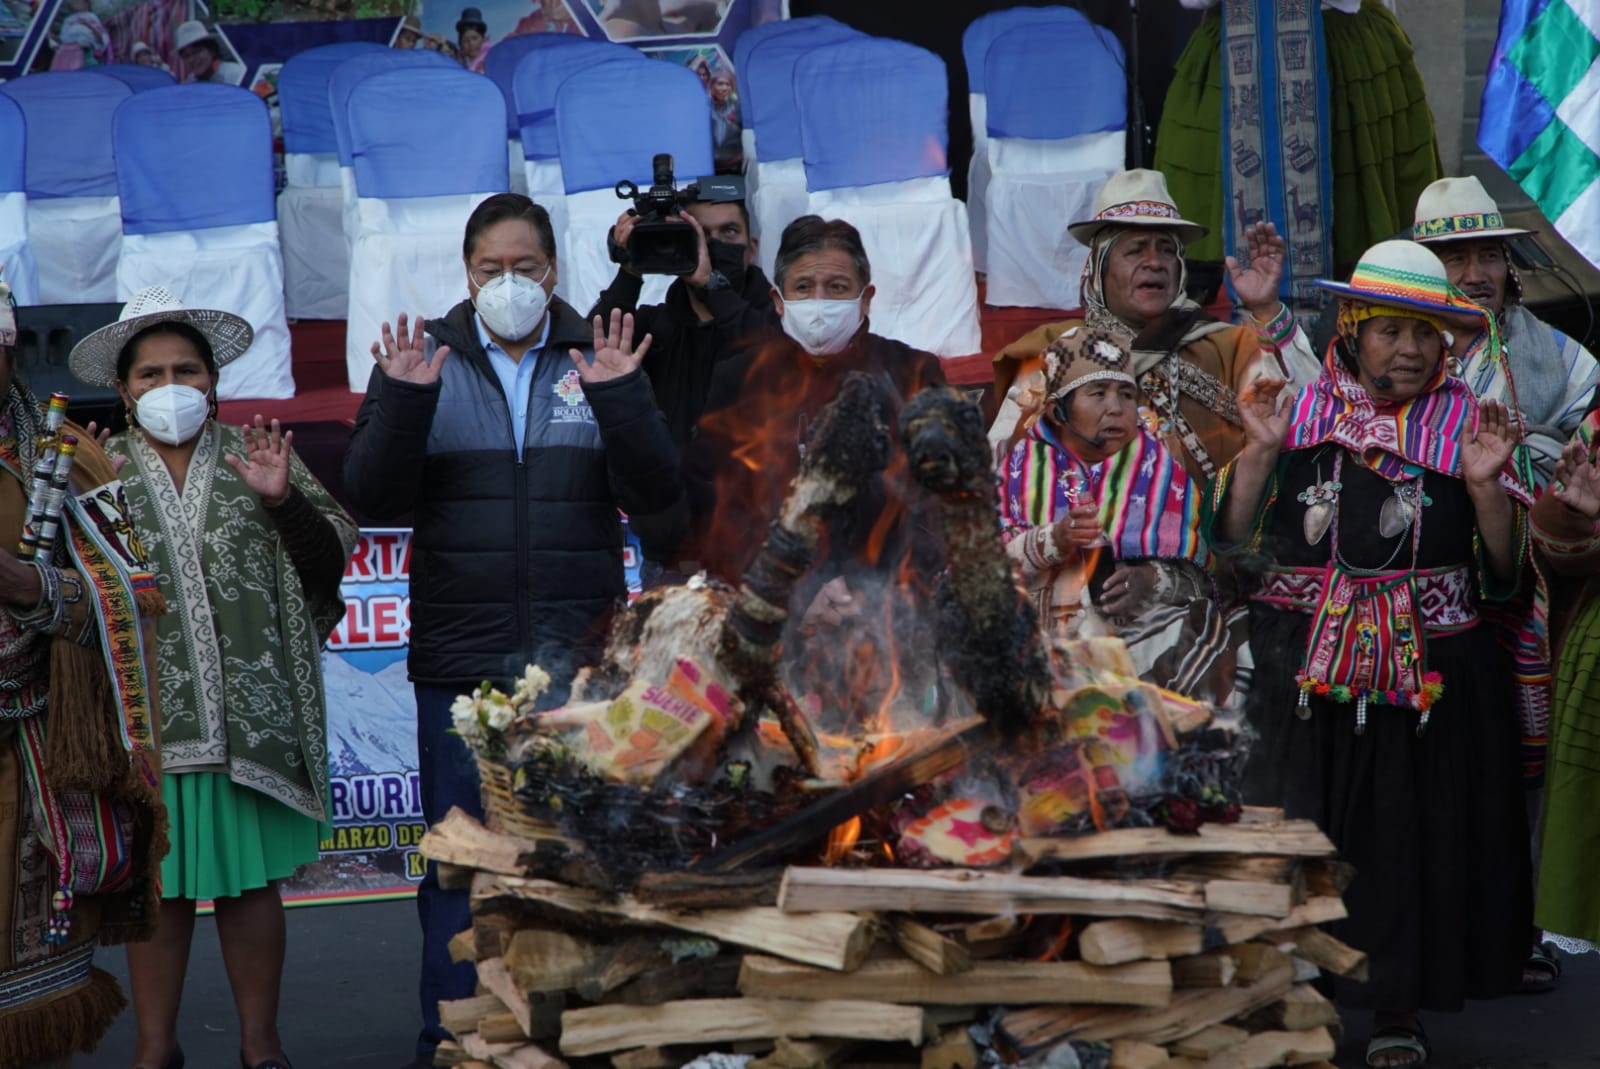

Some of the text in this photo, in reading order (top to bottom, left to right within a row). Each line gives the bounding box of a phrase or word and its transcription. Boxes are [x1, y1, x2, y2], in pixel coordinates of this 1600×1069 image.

[553, 407, 593, 417] BOLIVIA
[329, 602, 410, 644] LE
[641, 686, 703, 724] SUERTE
[321, 825, 424, 850] MARZO DE
